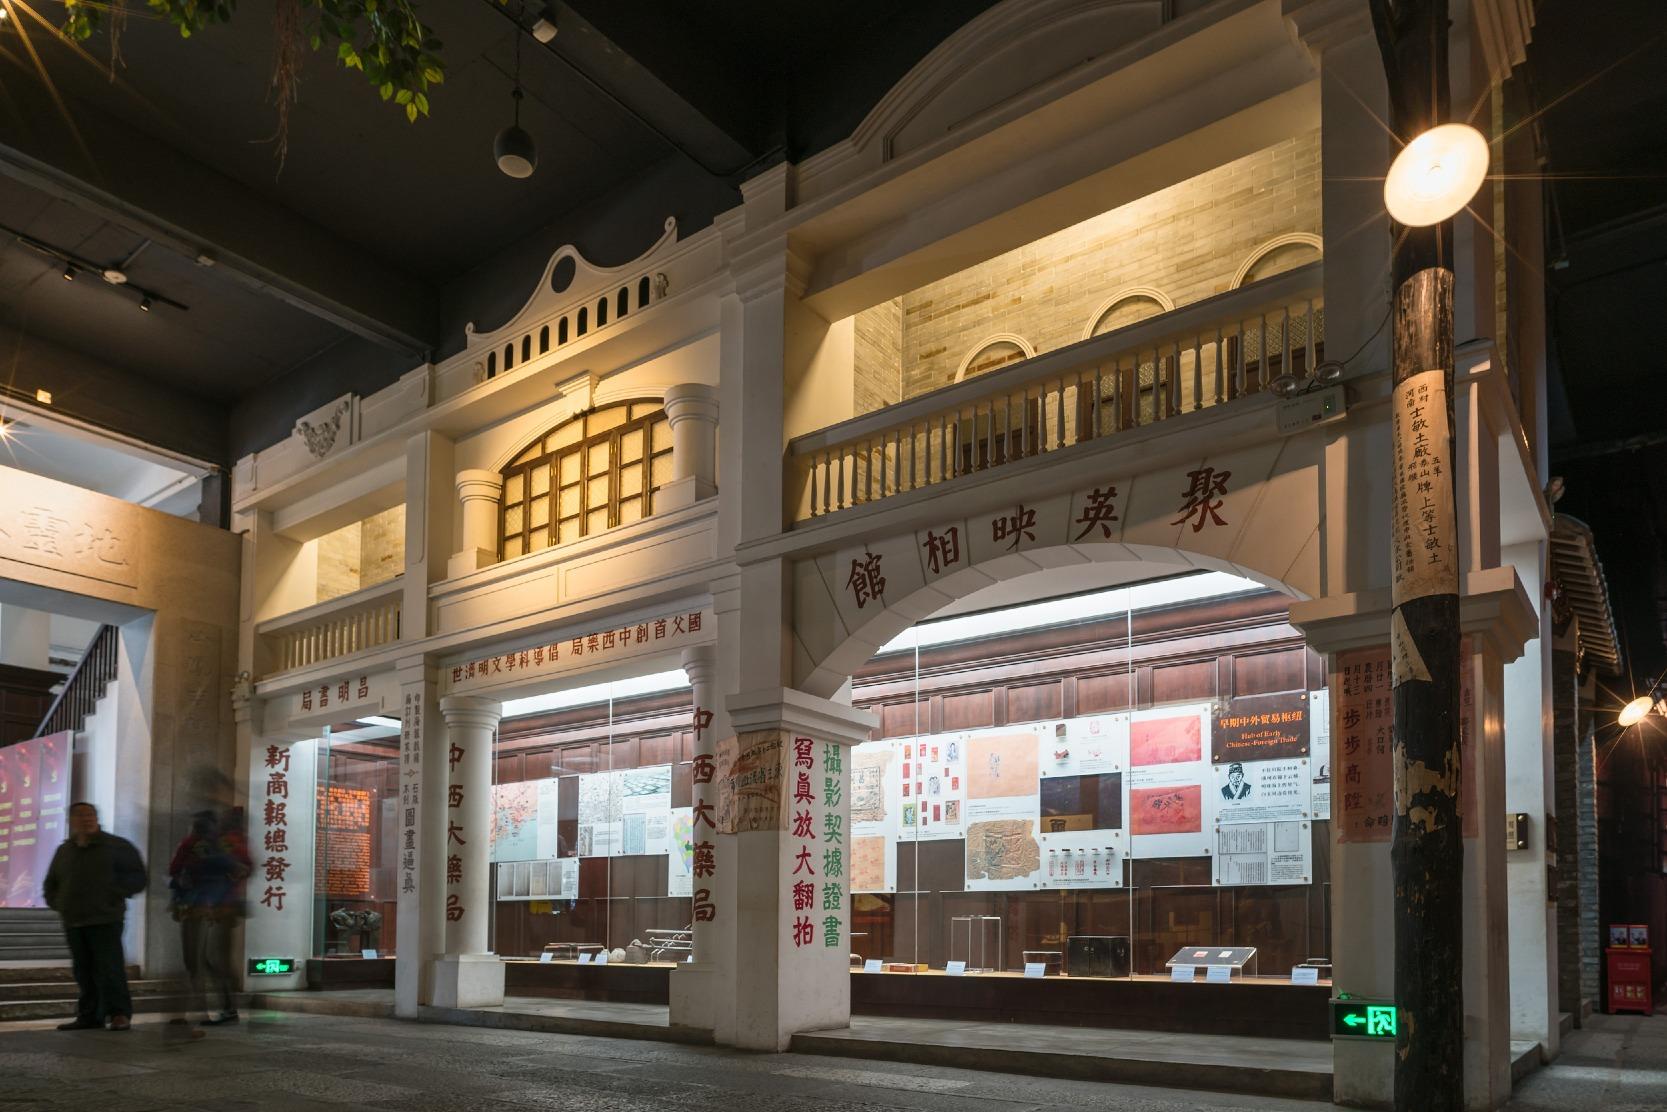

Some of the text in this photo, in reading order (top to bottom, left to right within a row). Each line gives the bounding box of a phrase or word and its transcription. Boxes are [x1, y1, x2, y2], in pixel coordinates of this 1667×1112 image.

[845, 466, 1232, 610] 聚英映相館
[300, 675, 370, 713] 昌明書局
[1220, 711, 1303, 729] 早期中外贸易枢纽
[1226, 737, 1278, 748] Chinese-Foreign
[260, 743, 292, 912] 新商報總發行
[692, 706, 717, 923] 中西大藥局
[821, 743, 843, 948] 攝影契據證書
